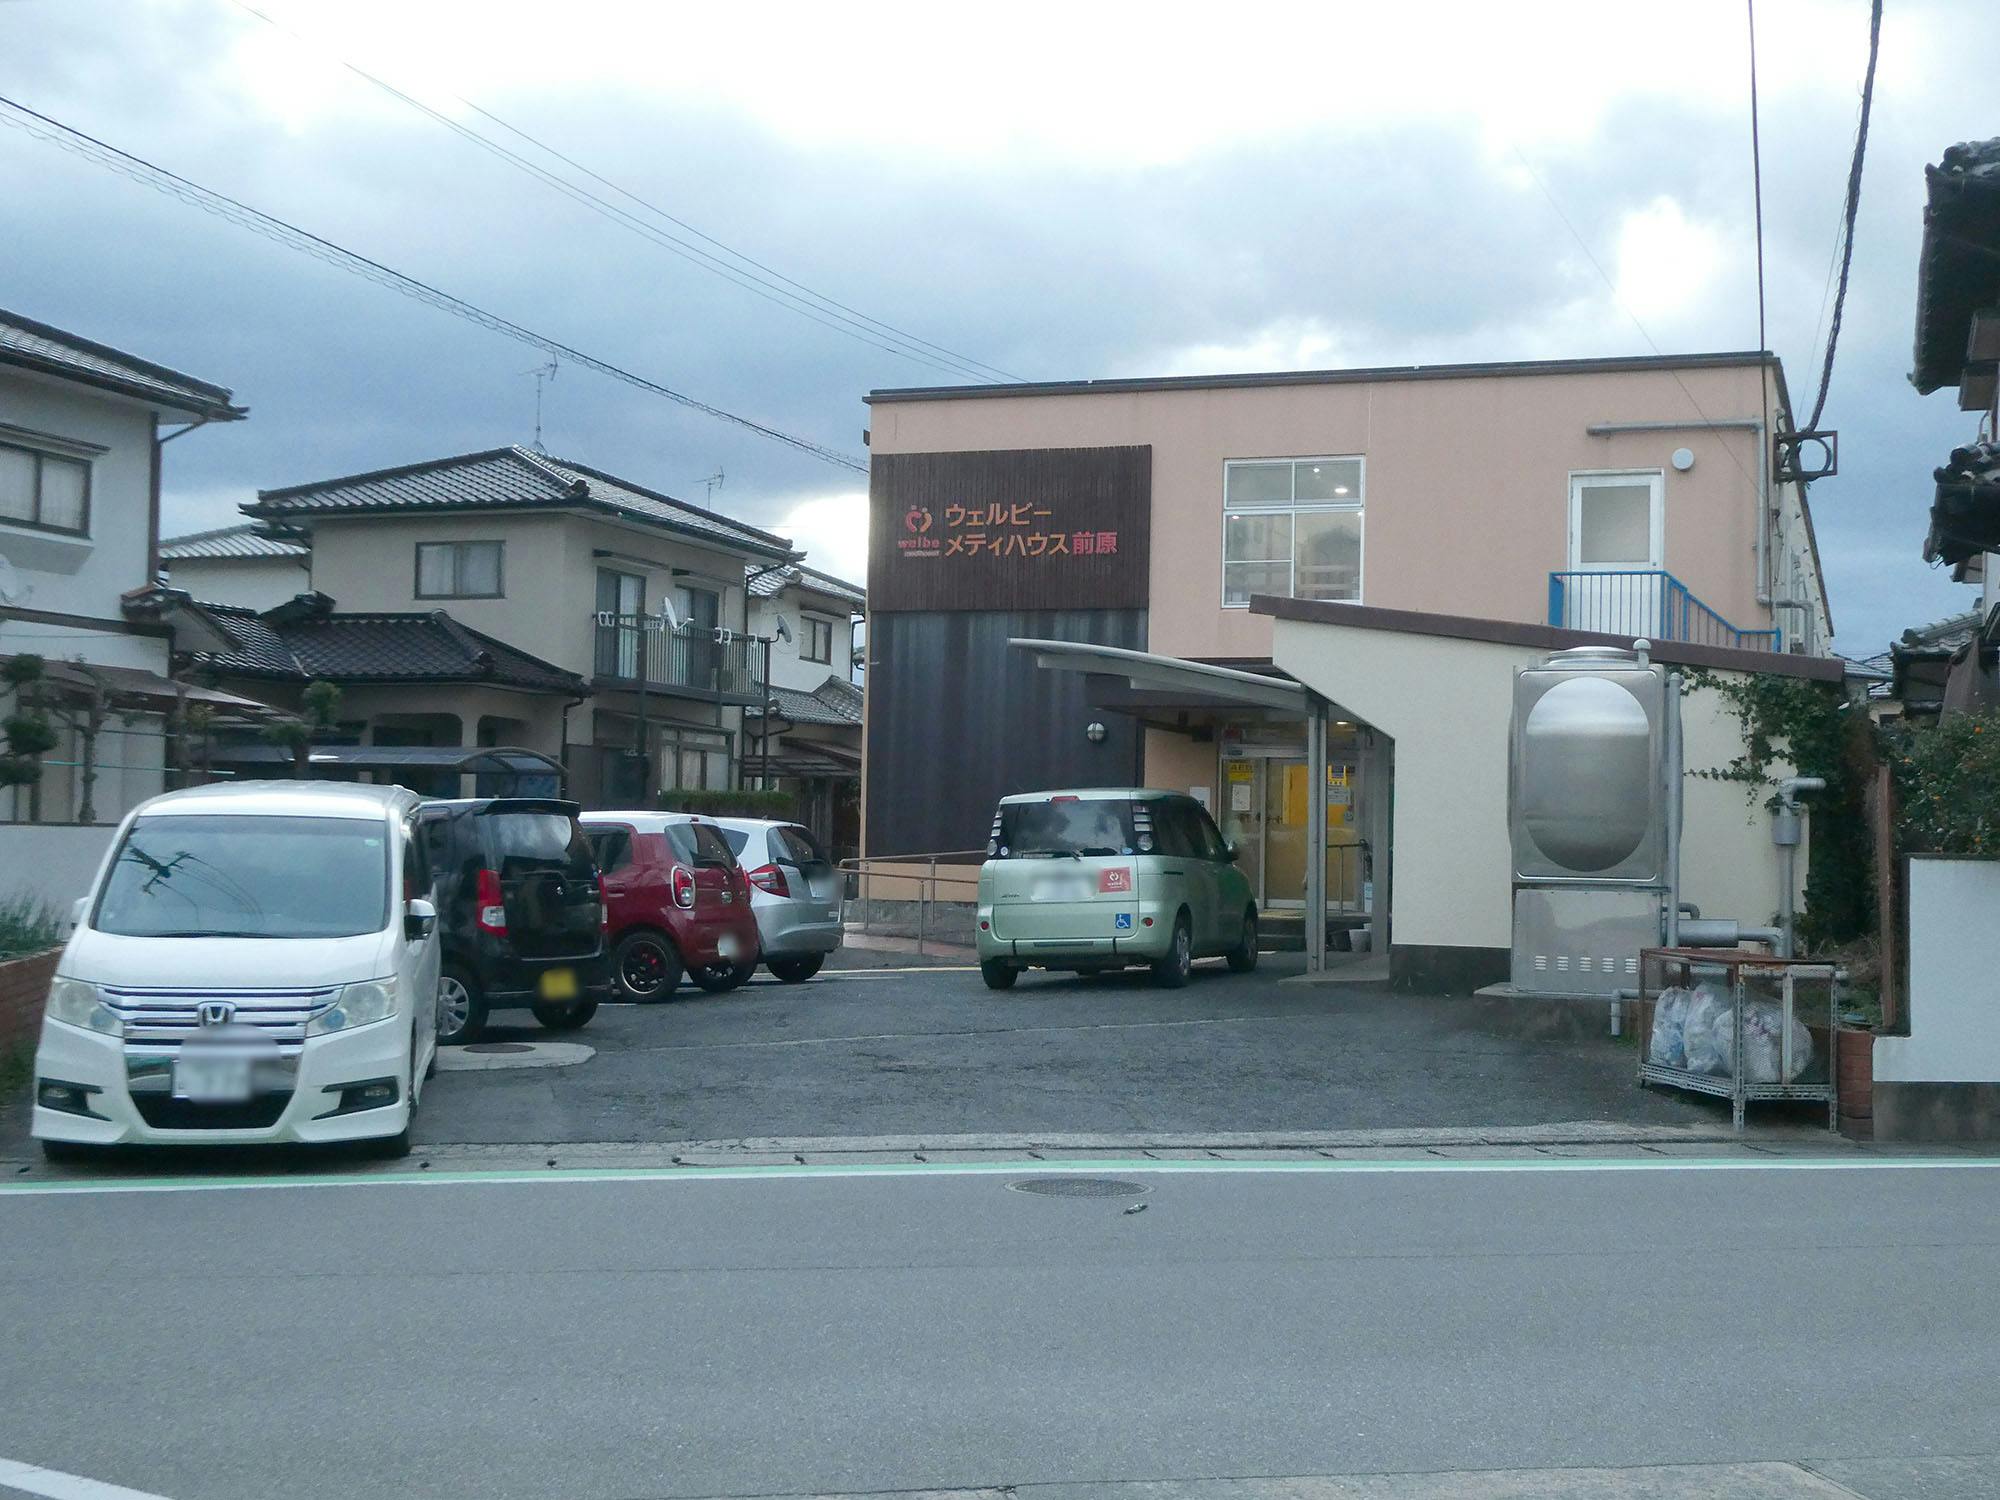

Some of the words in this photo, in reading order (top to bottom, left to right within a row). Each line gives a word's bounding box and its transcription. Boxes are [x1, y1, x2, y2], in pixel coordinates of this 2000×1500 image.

[945, 502, 1052, 527] ウェルビー
